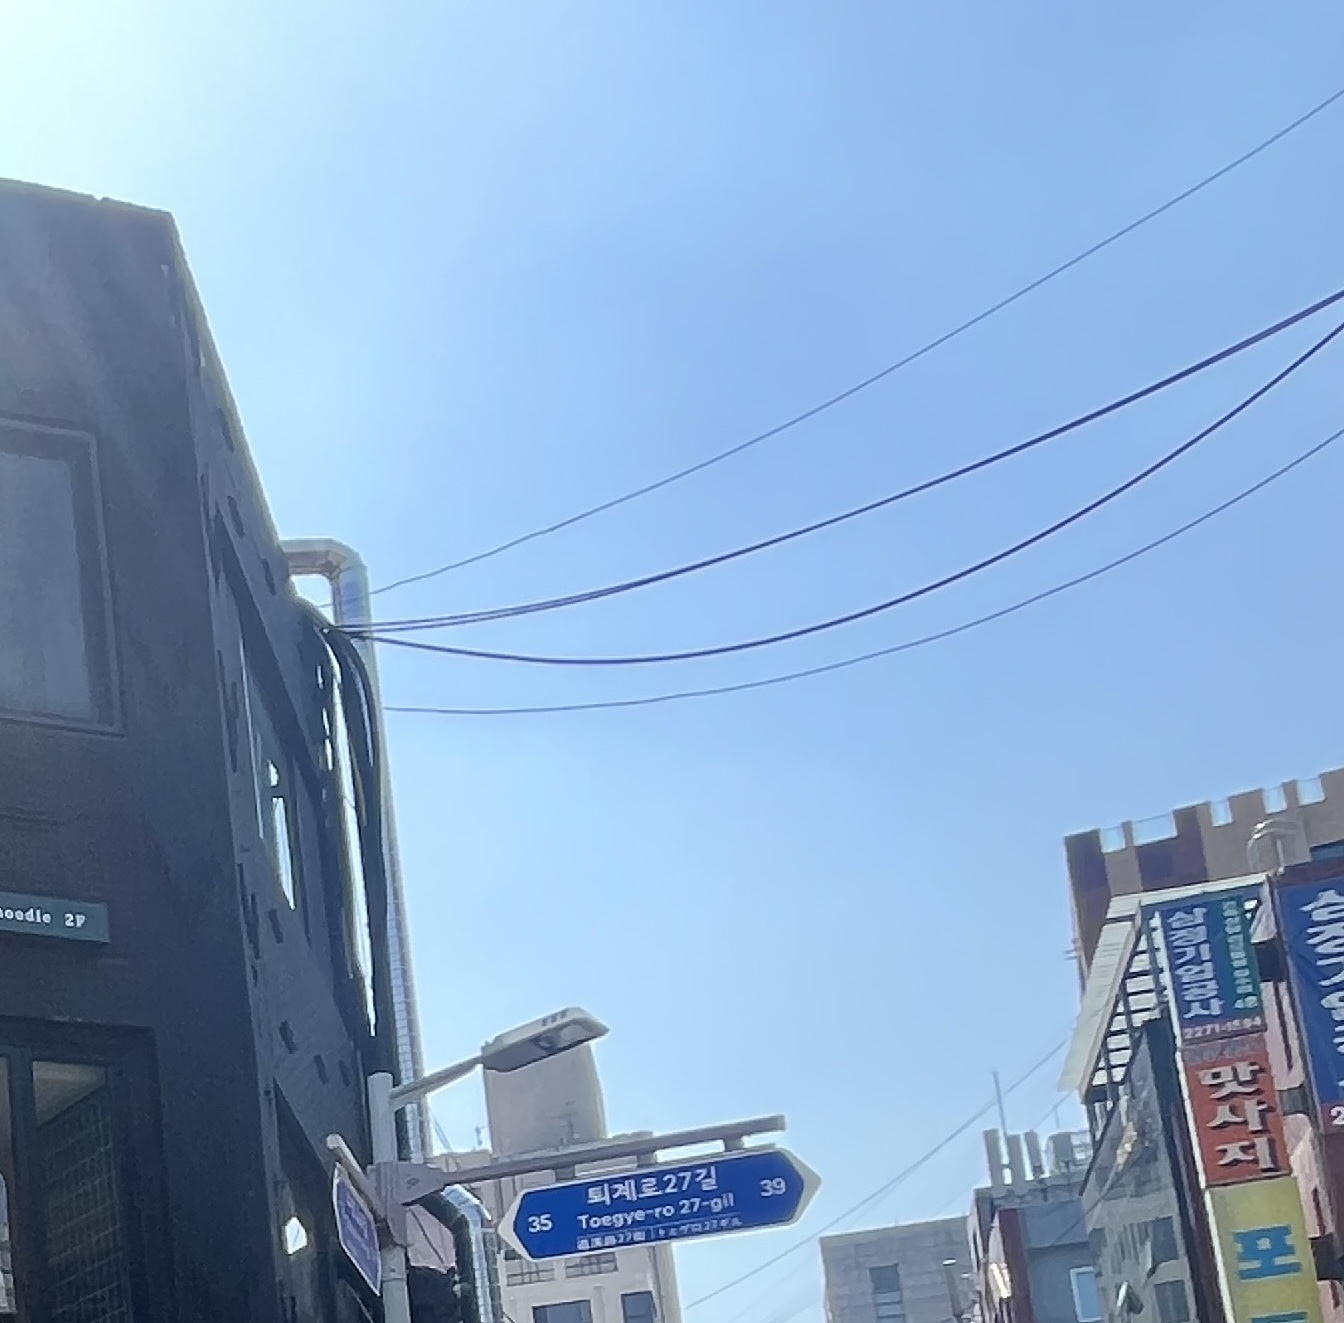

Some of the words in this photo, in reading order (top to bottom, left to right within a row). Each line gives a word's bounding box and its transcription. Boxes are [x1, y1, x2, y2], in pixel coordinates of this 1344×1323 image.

[1199, 1060, 1279, 1177] 맛사지
[586, 1165, 718, 1205] 퇴계로27길
[759, 1177, 787, 1197] 39
[528, 1213, 553, 1233] 35
[577, 1203, 676, 1231] Toegye-ro
[678, 1193, 735, 1218] 27-gil
